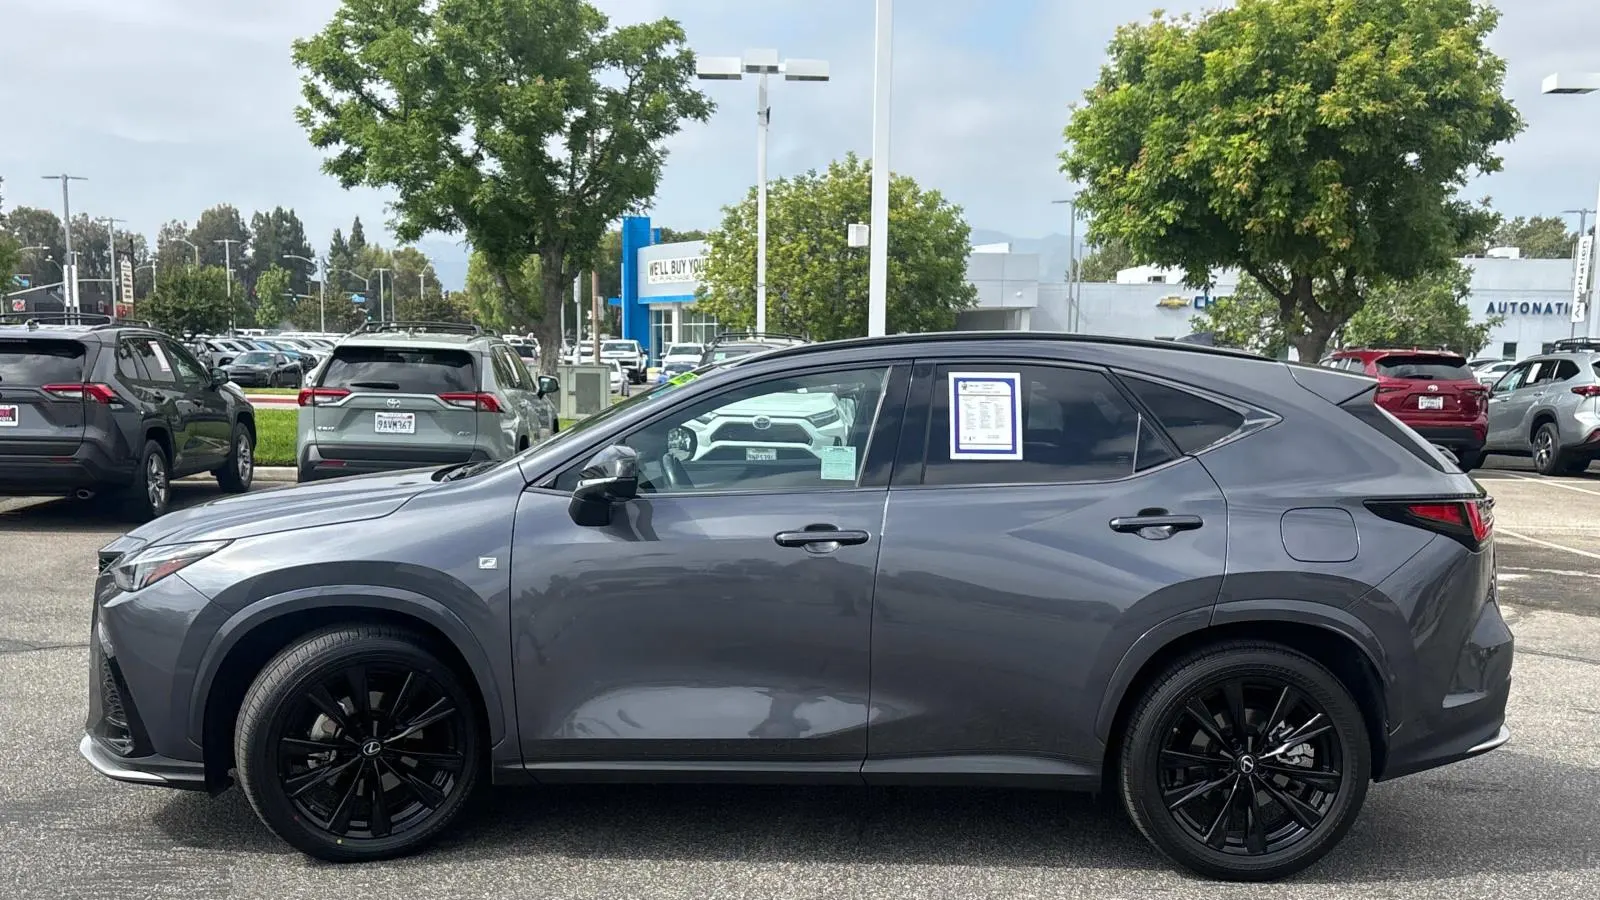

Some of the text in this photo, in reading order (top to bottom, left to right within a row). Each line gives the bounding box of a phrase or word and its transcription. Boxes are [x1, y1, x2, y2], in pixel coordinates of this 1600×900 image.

[650, 261, 668, 275] WE'LL
[671, 260, 686, 274] BUY
[1486, 302, 1573, 315] AUTONATI
